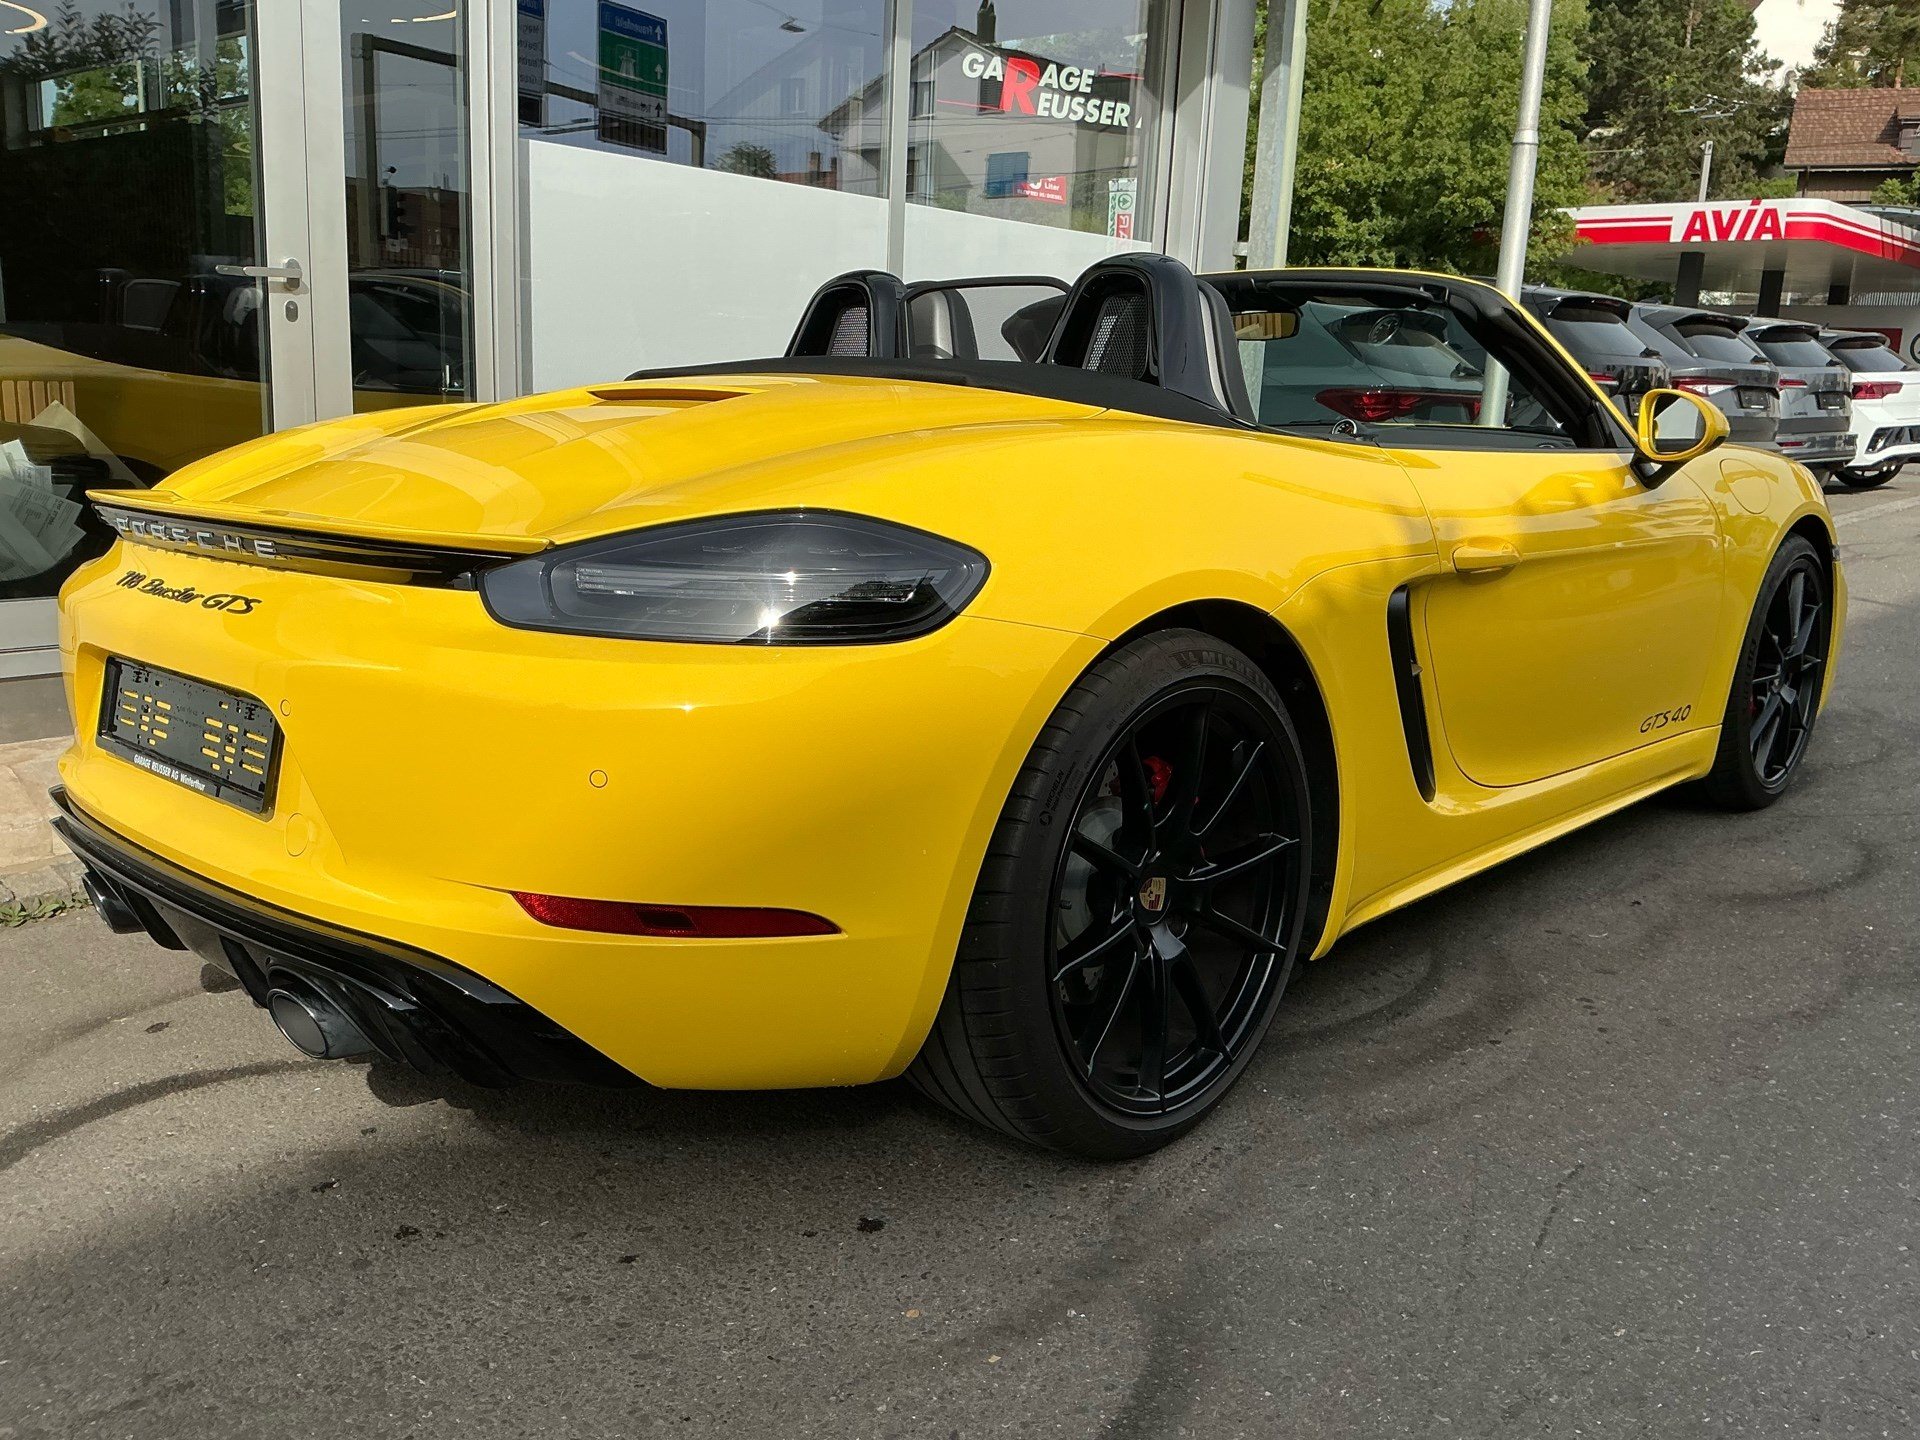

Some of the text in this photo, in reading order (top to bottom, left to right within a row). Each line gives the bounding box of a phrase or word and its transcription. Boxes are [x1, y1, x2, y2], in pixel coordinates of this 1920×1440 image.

[962, 52, 1094, 115] GARAGE
[1681, 198, 1783, 242] AVIA
[116, 517, 277, 559] PORSCHE
[138, 578, 203, 604] Boxster
[201, 593, 262, 615] GTS
[1640, 704, 1691, 733] GTS 4.0
[134, 754, 206, 791] GARAGE REUSSER AG Winterthur
